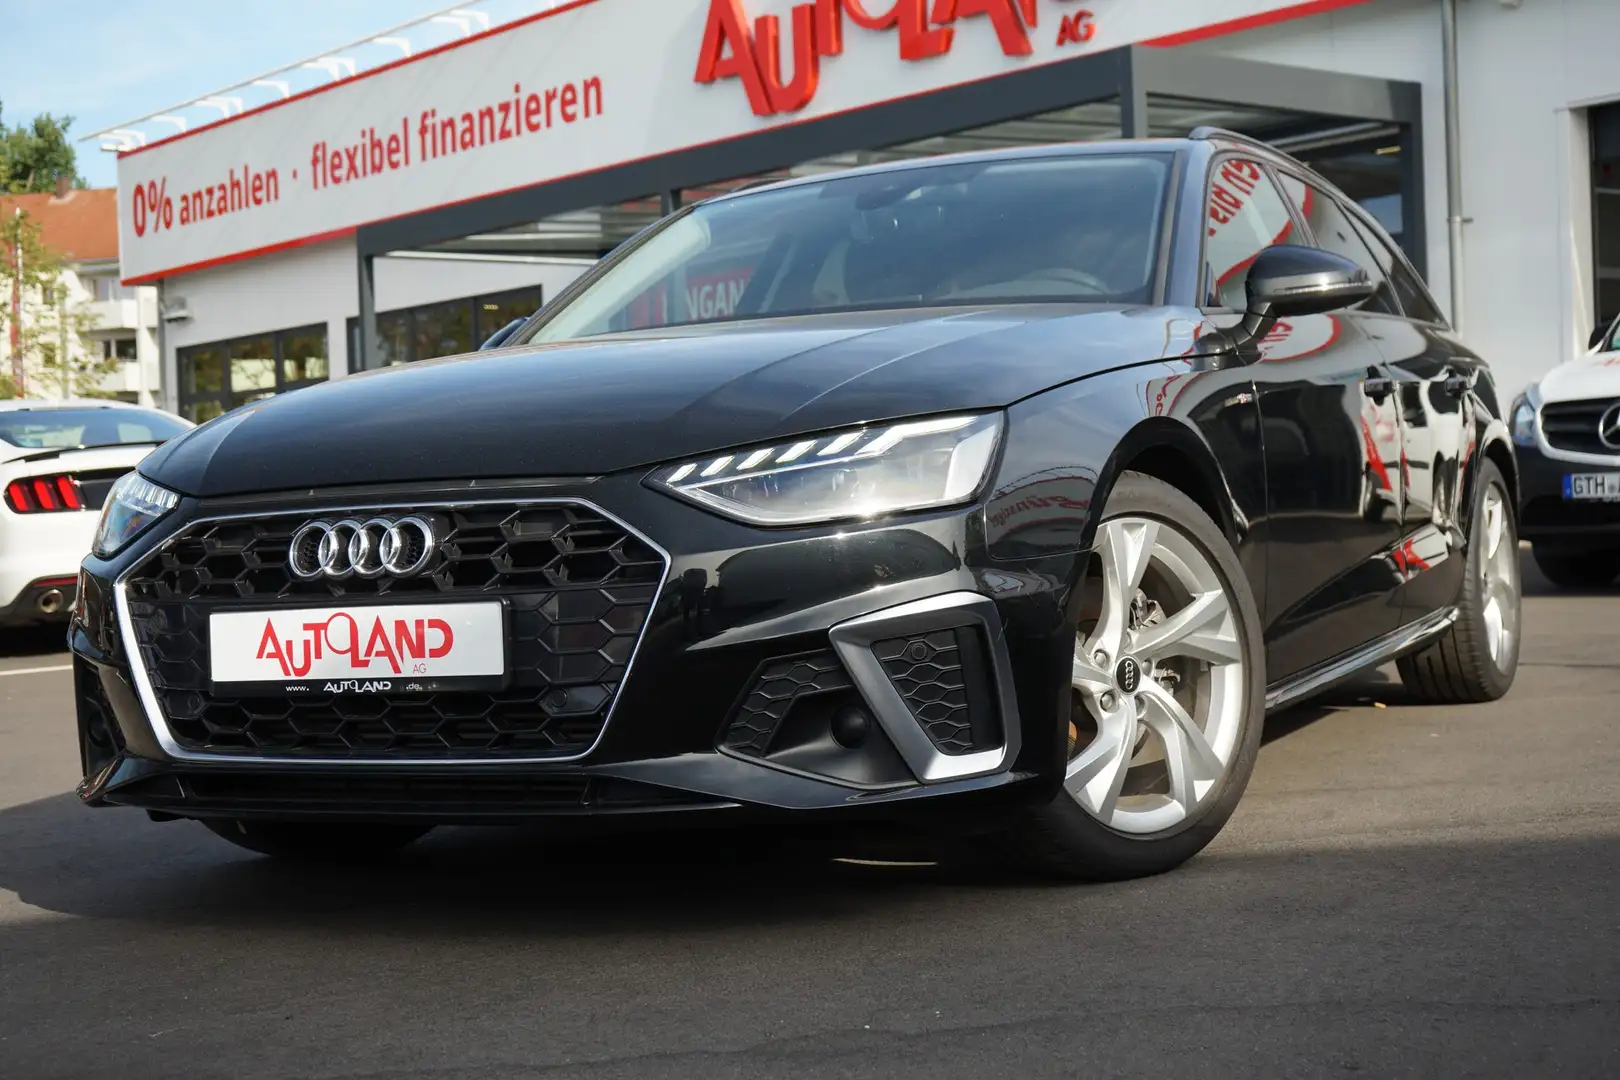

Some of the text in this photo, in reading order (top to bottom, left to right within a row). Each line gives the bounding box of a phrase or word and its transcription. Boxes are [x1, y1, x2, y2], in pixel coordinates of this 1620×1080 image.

[1056, 9, 1096, 47] AG
[132, 75, 604, 237] 0% anzahlen flexibel finanzieren
[1574, 475, 1605, 495] GTH
[256, 612, 454, 677] AUTOLAND
[412, 663, 427, 674] AG
[286, 684, 310, 692] www.
[323, 679, 392, 693] AUTOLAND
